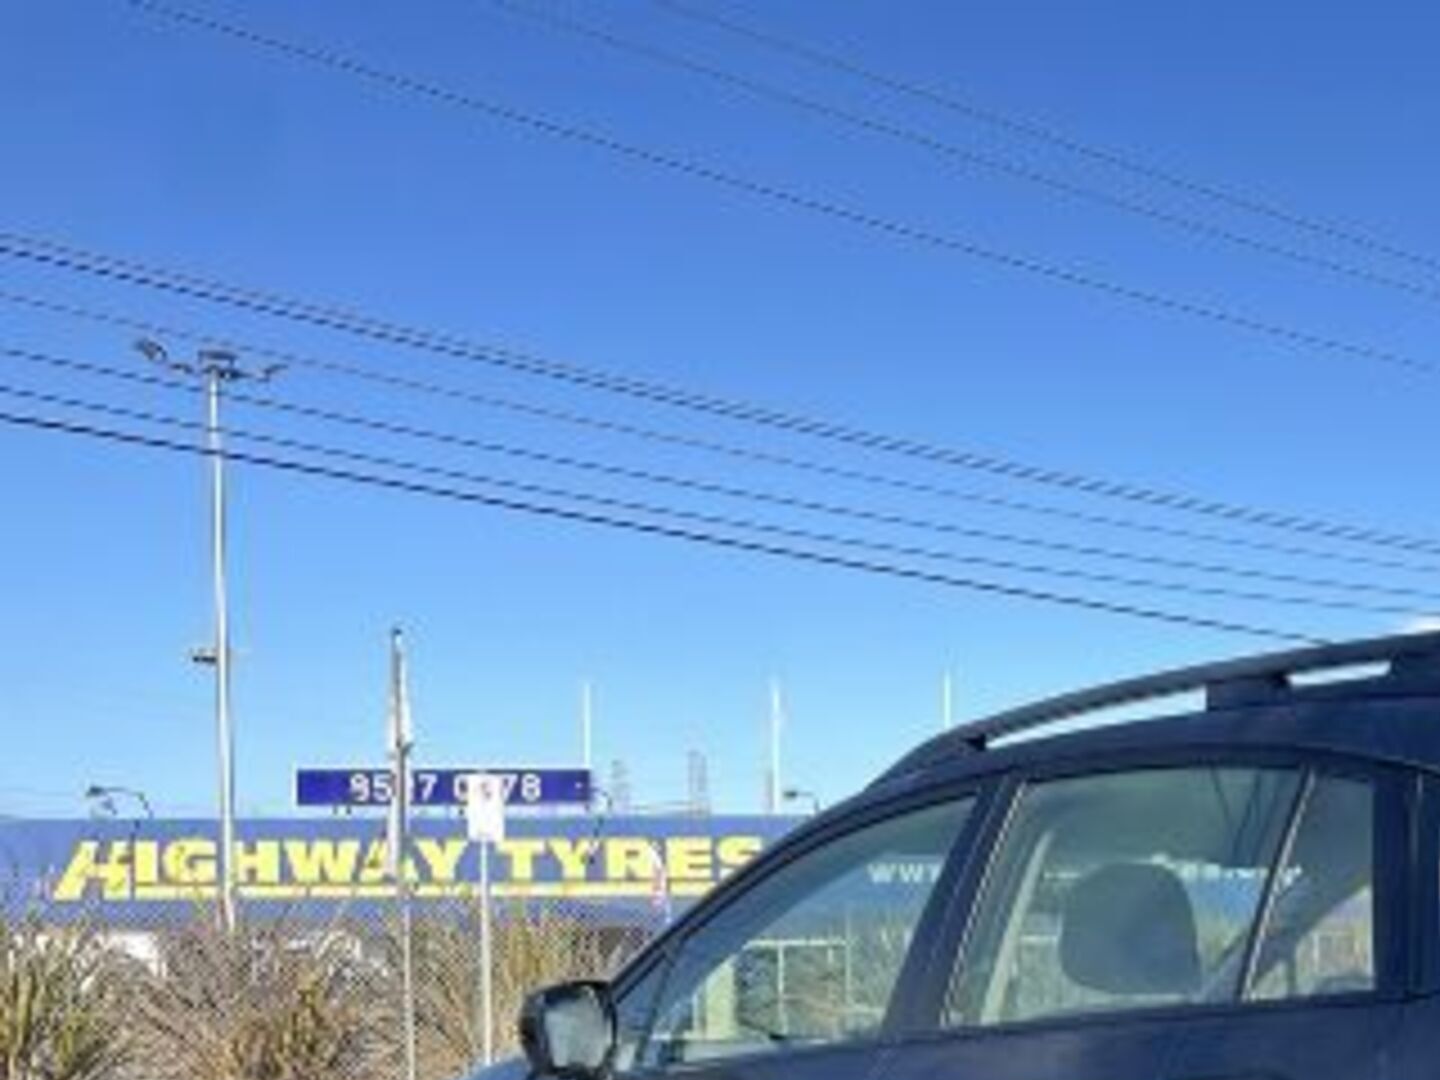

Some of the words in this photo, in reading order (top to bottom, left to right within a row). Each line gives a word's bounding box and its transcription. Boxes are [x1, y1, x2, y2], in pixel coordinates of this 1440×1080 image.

[350, 772, 438, 802] 957
[452, 772, 542, 802] 078
[53, 838, 471, 900] HIGHWAY
[499, 835, 764, 881] TYRES
